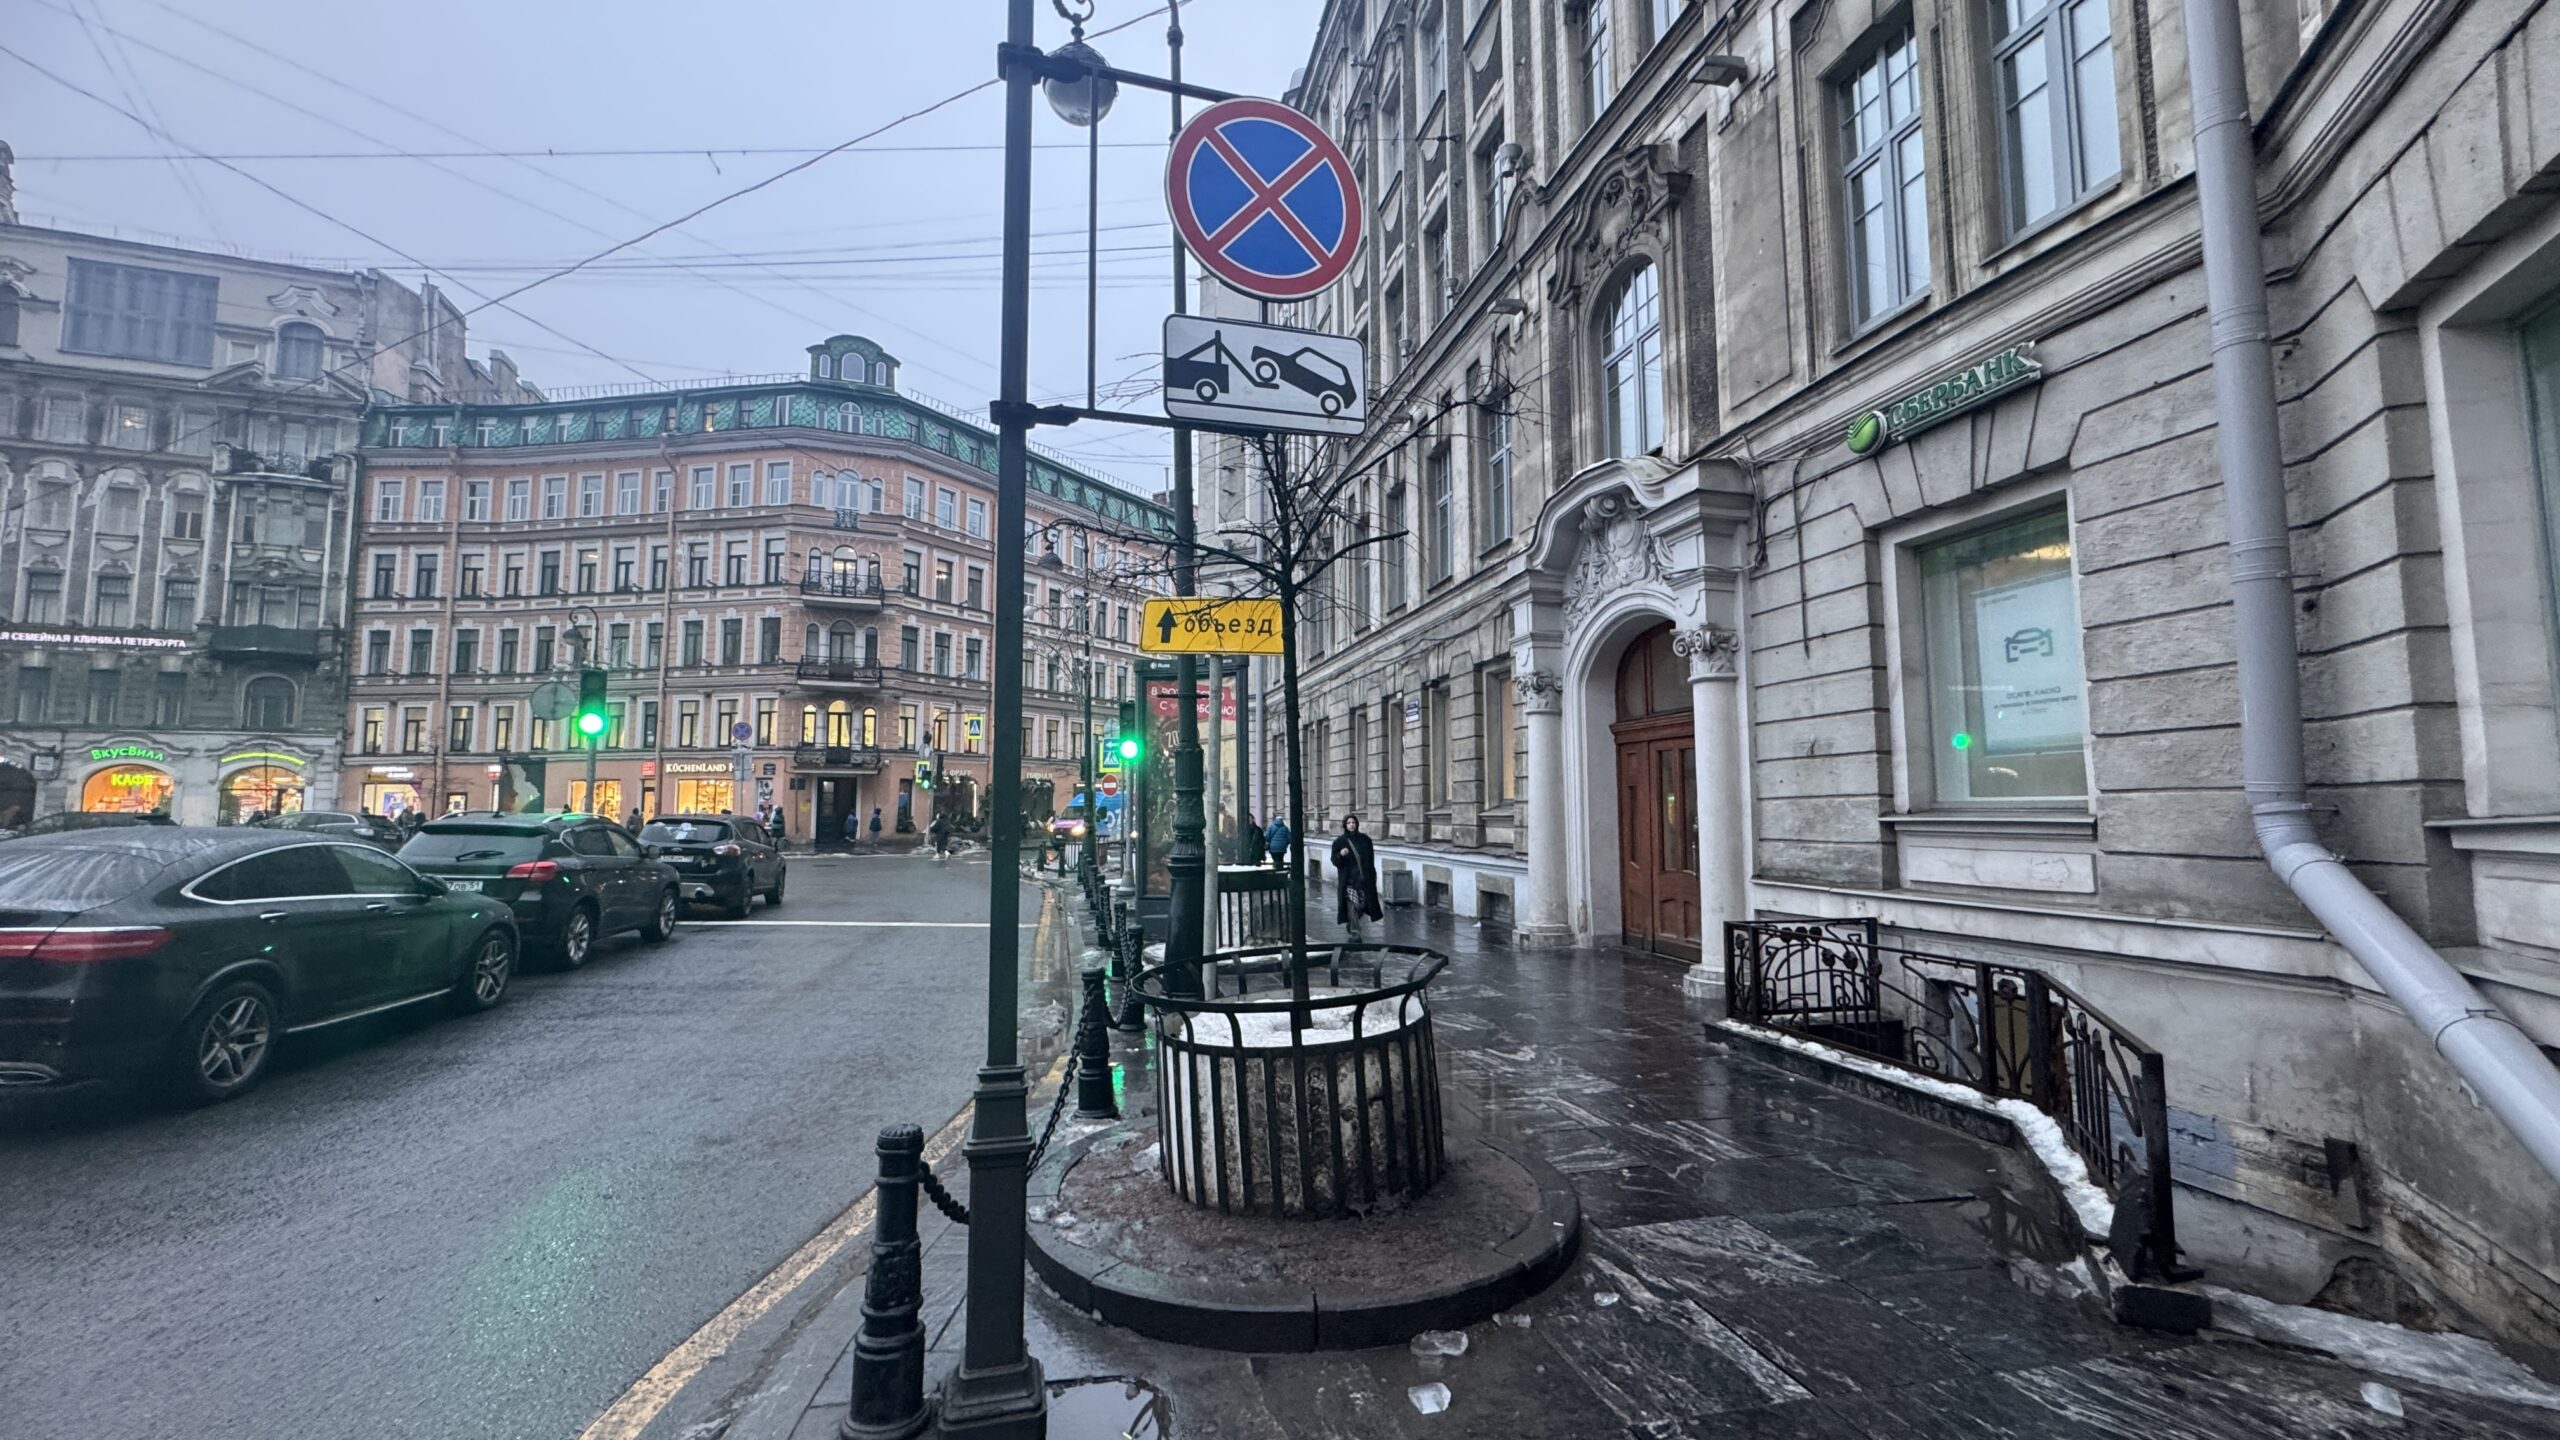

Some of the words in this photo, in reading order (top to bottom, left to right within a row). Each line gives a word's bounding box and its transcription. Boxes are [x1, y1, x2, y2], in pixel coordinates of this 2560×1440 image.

[1886, 344, 2034, 428] СБЕРБАНК
[1184, 612, 1273, 637] объезд
[11, 631, 70, 643] СЕМЕЙНАЯ
[73, 634, 121, 645] КЛИНИКА
[122, 637, 186, 648] ПЕТЕРБУРГА
[91, 745, 165, 761] ВкусВилл
[111, 773, 154, 787] КАФЕ
